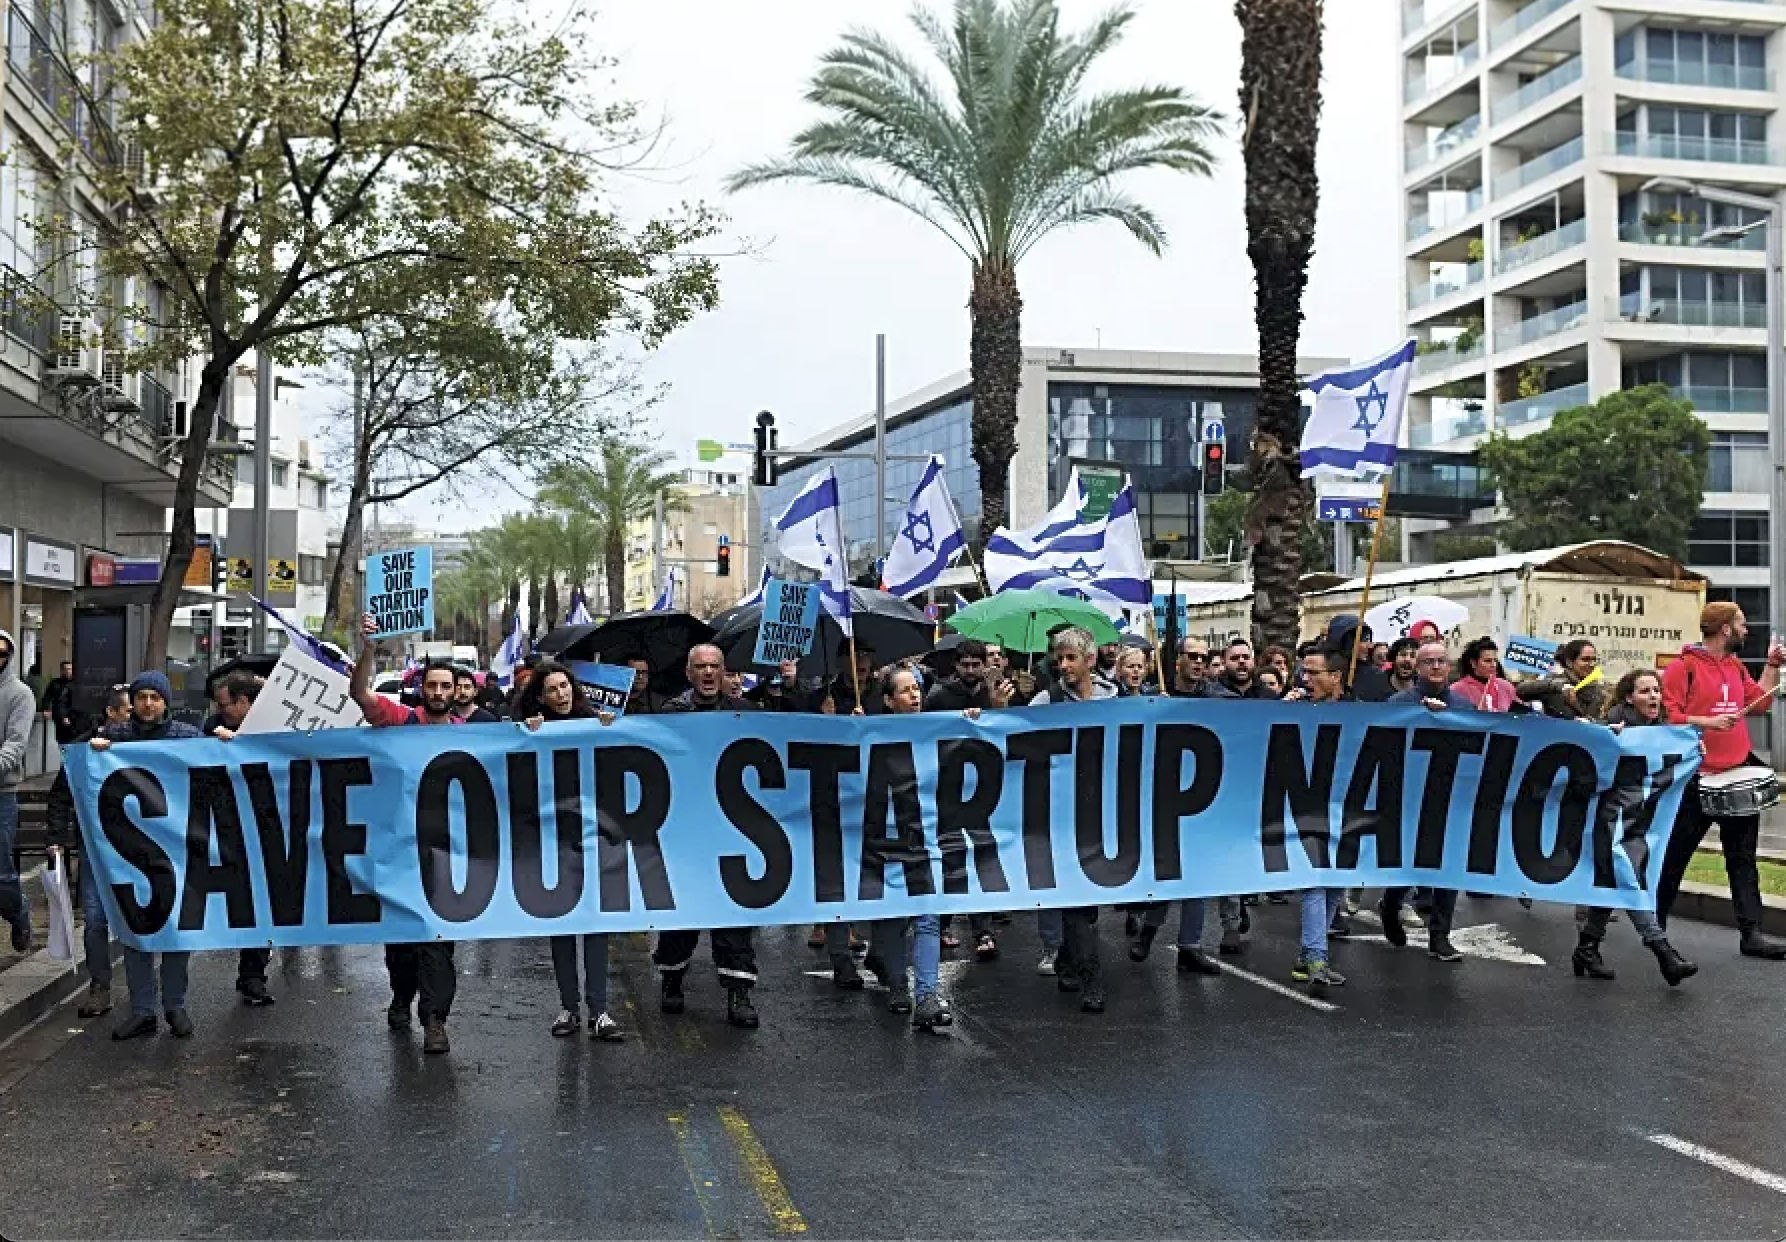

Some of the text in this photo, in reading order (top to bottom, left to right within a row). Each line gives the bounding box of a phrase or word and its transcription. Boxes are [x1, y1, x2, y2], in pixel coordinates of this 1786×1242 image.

[382, 552, 416, 574] SAVE
[385, 572, 413, 593] OUR
[780, 583, 809, 606] SAVE
[370, 588, 428, 615] STARTUP
[1594, 588, 1644, 616] גולני
[376, 608, 425, 635] NATION
[780, 604, 803, 625] OUR
[762, 622, 812, 646] STARTUP
[99, 723, 1682, 935] SAVE OUR STARTUP NATION
